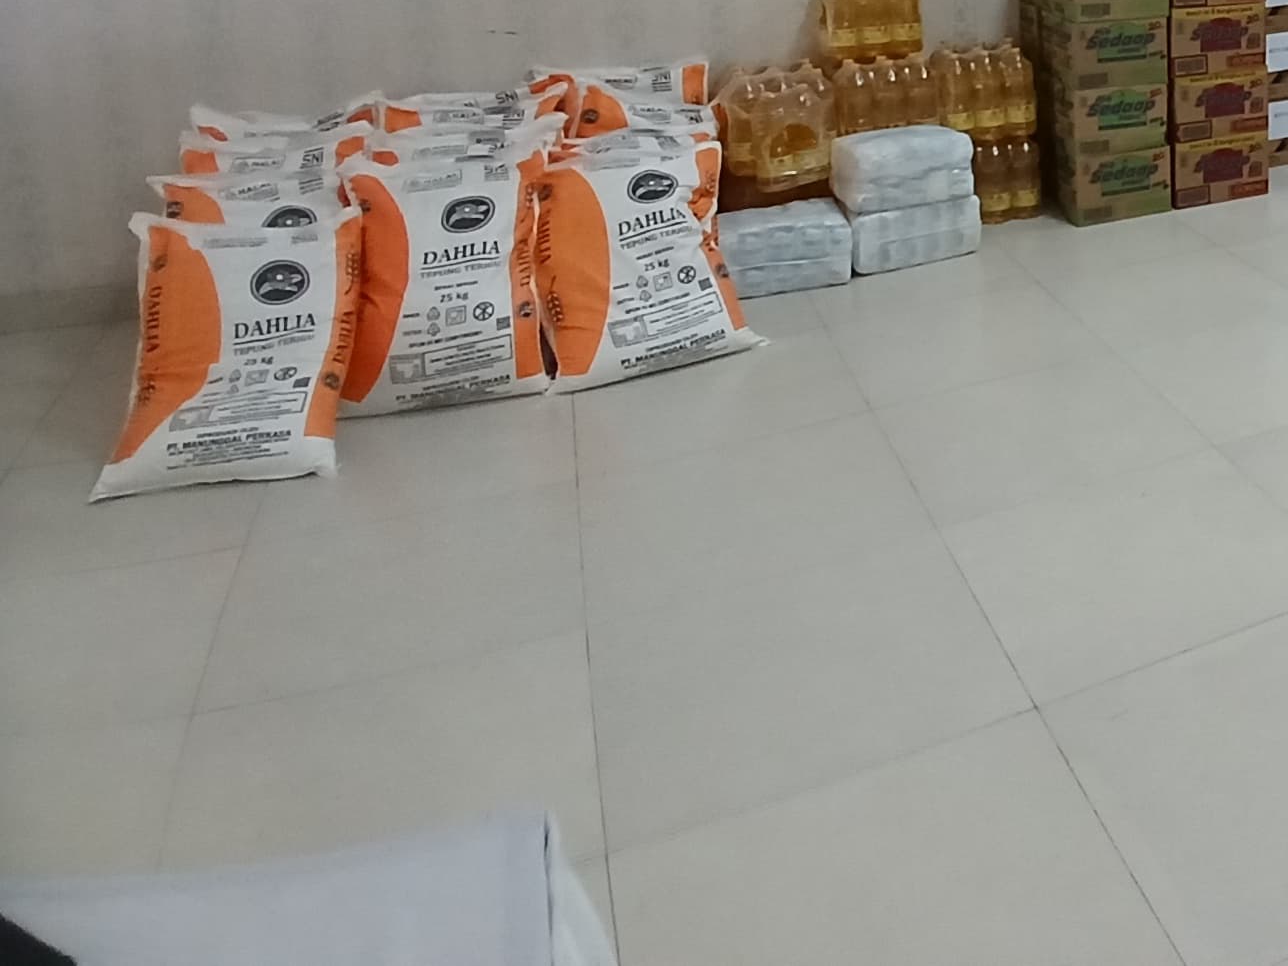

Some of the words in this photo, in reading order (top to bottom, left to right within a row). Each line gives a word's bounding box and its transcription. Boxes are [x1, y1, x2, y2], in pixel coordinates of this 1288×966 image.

[1086, 32, 1156, 51] Sedaap
[495, 90, 520, 106] SNI
[1086, 98, 1156, 118] Sedaap
[302, 151, 324, 165] SNI
[618, 207, 687, 237] DAHLIA
[423, 240, 501, 265] DAHLIA
[233, 313, 316, 339] DAHLIA
